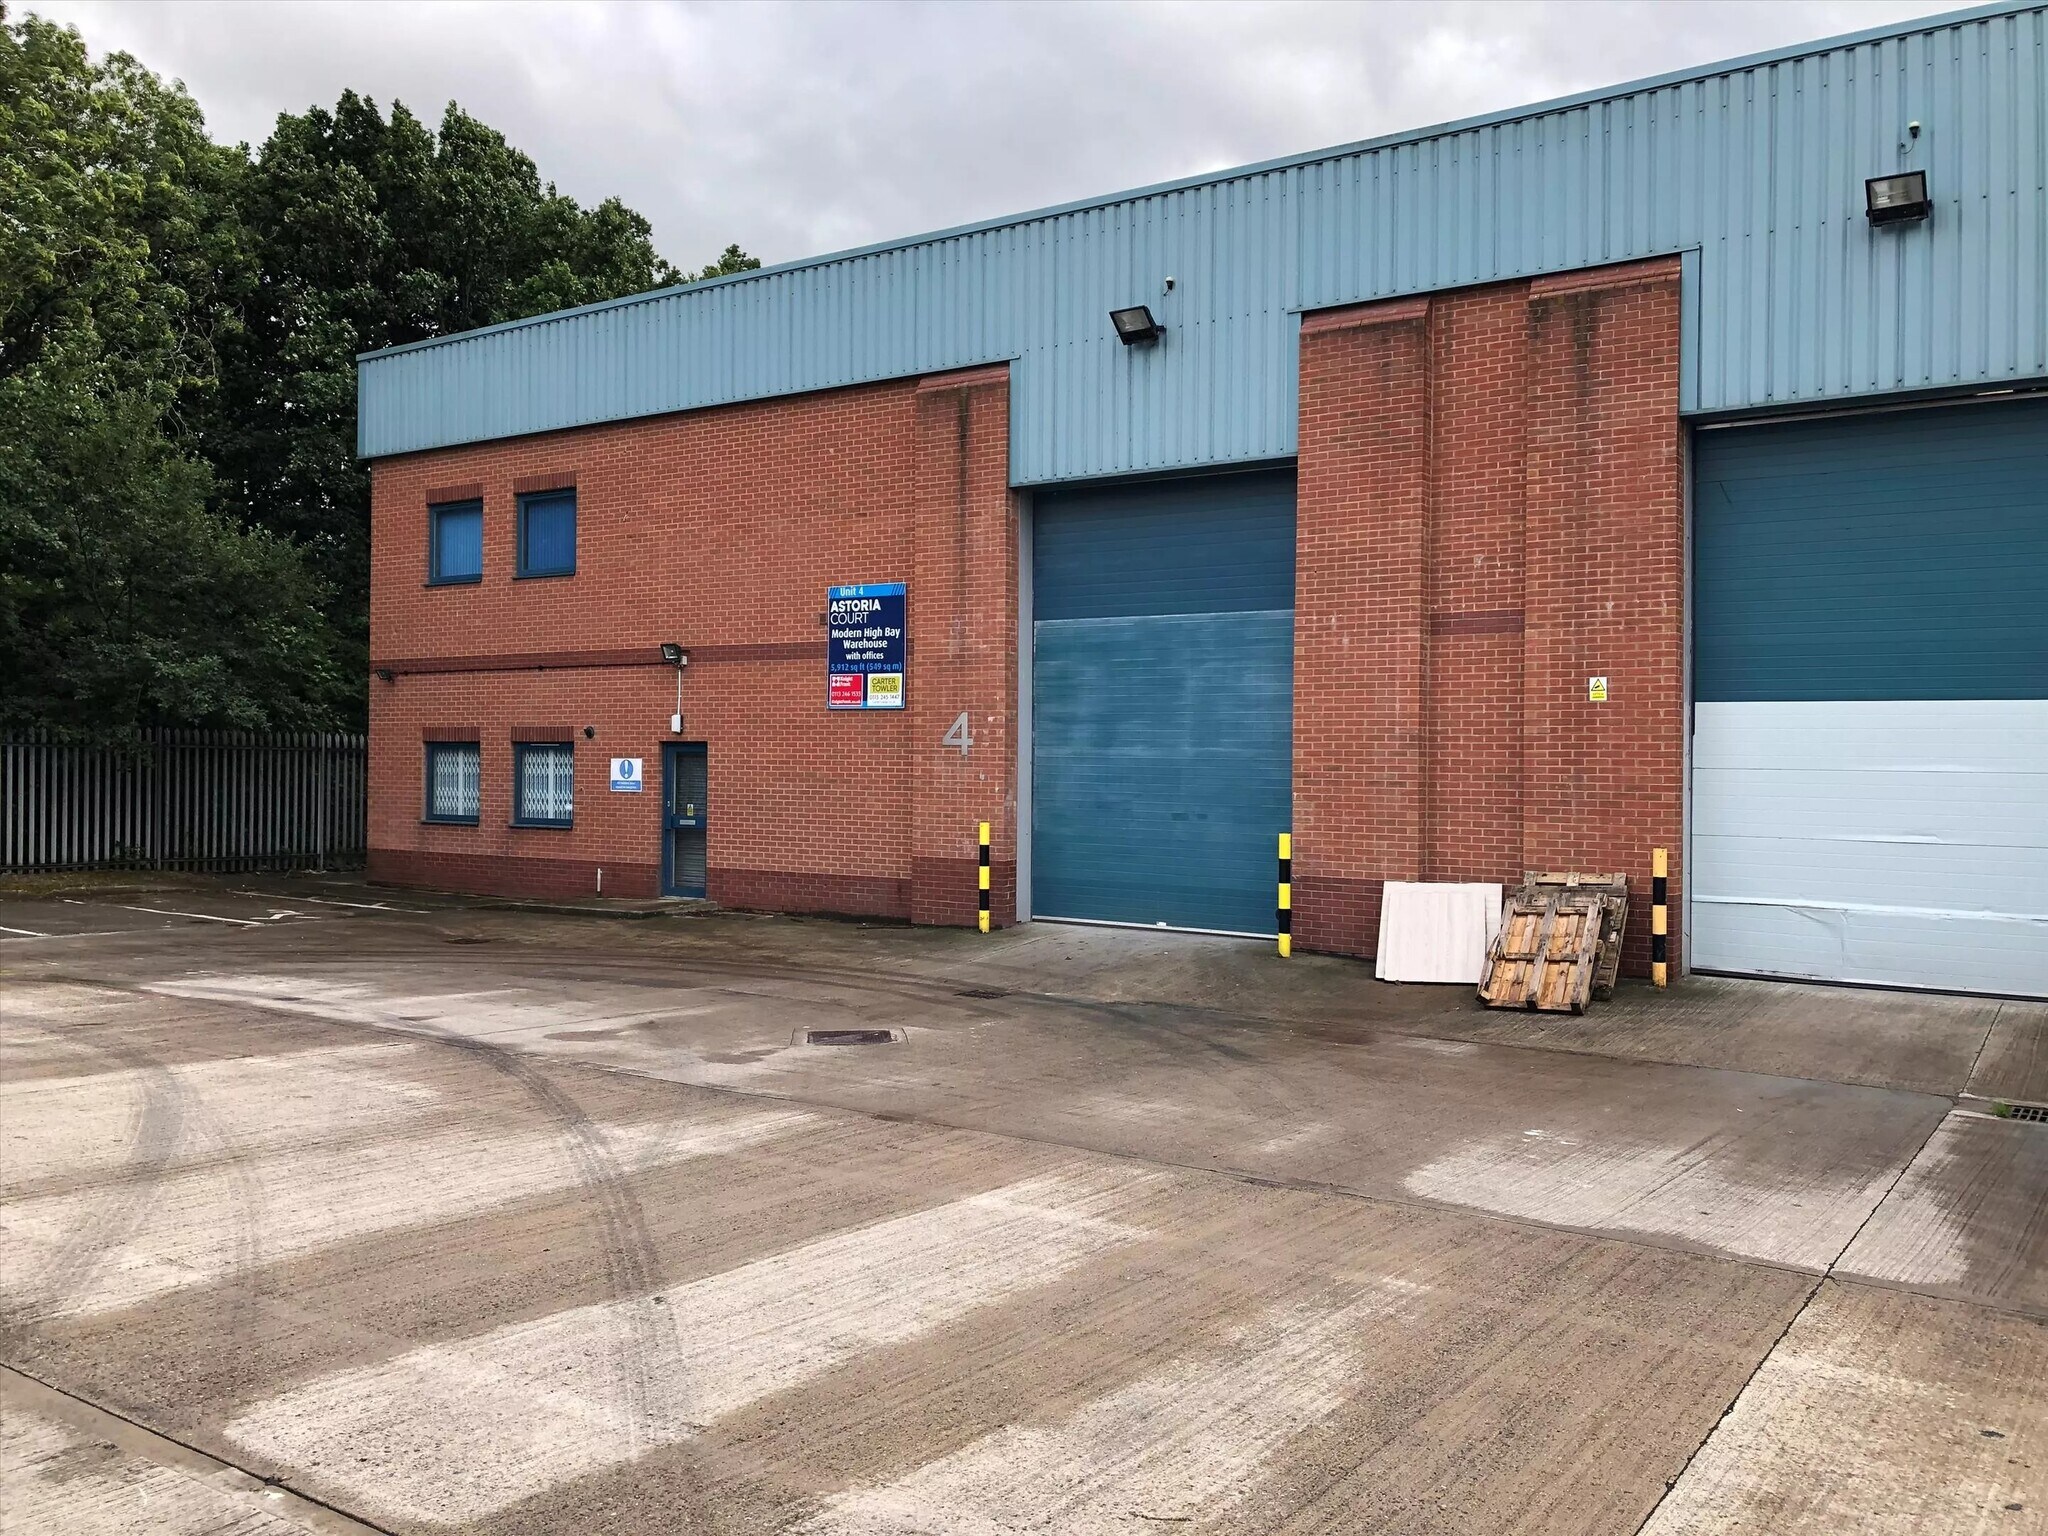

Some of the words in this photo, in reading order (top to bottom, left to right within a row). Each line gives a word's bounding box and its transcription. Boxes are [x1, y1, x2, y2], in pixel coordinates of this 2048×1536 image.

[840, 586, 856, 596] Unit
[859, 586, 864, 595] 4
[831, 599, 881, 612] ASTORIA
[831, 612, 869, 624] COURT
[832, 628, 861, 638] Modern
[864, 627, 882, 639] High
[885, 627, 900, 638] Bay
[843, 638, 888, 648] Warehouse
[846, 652, 860, 660] with
[862, 651, 884, 660] offices
[831, 663, 849, 672] 5,912
[942, 711, 974, 755] 4
